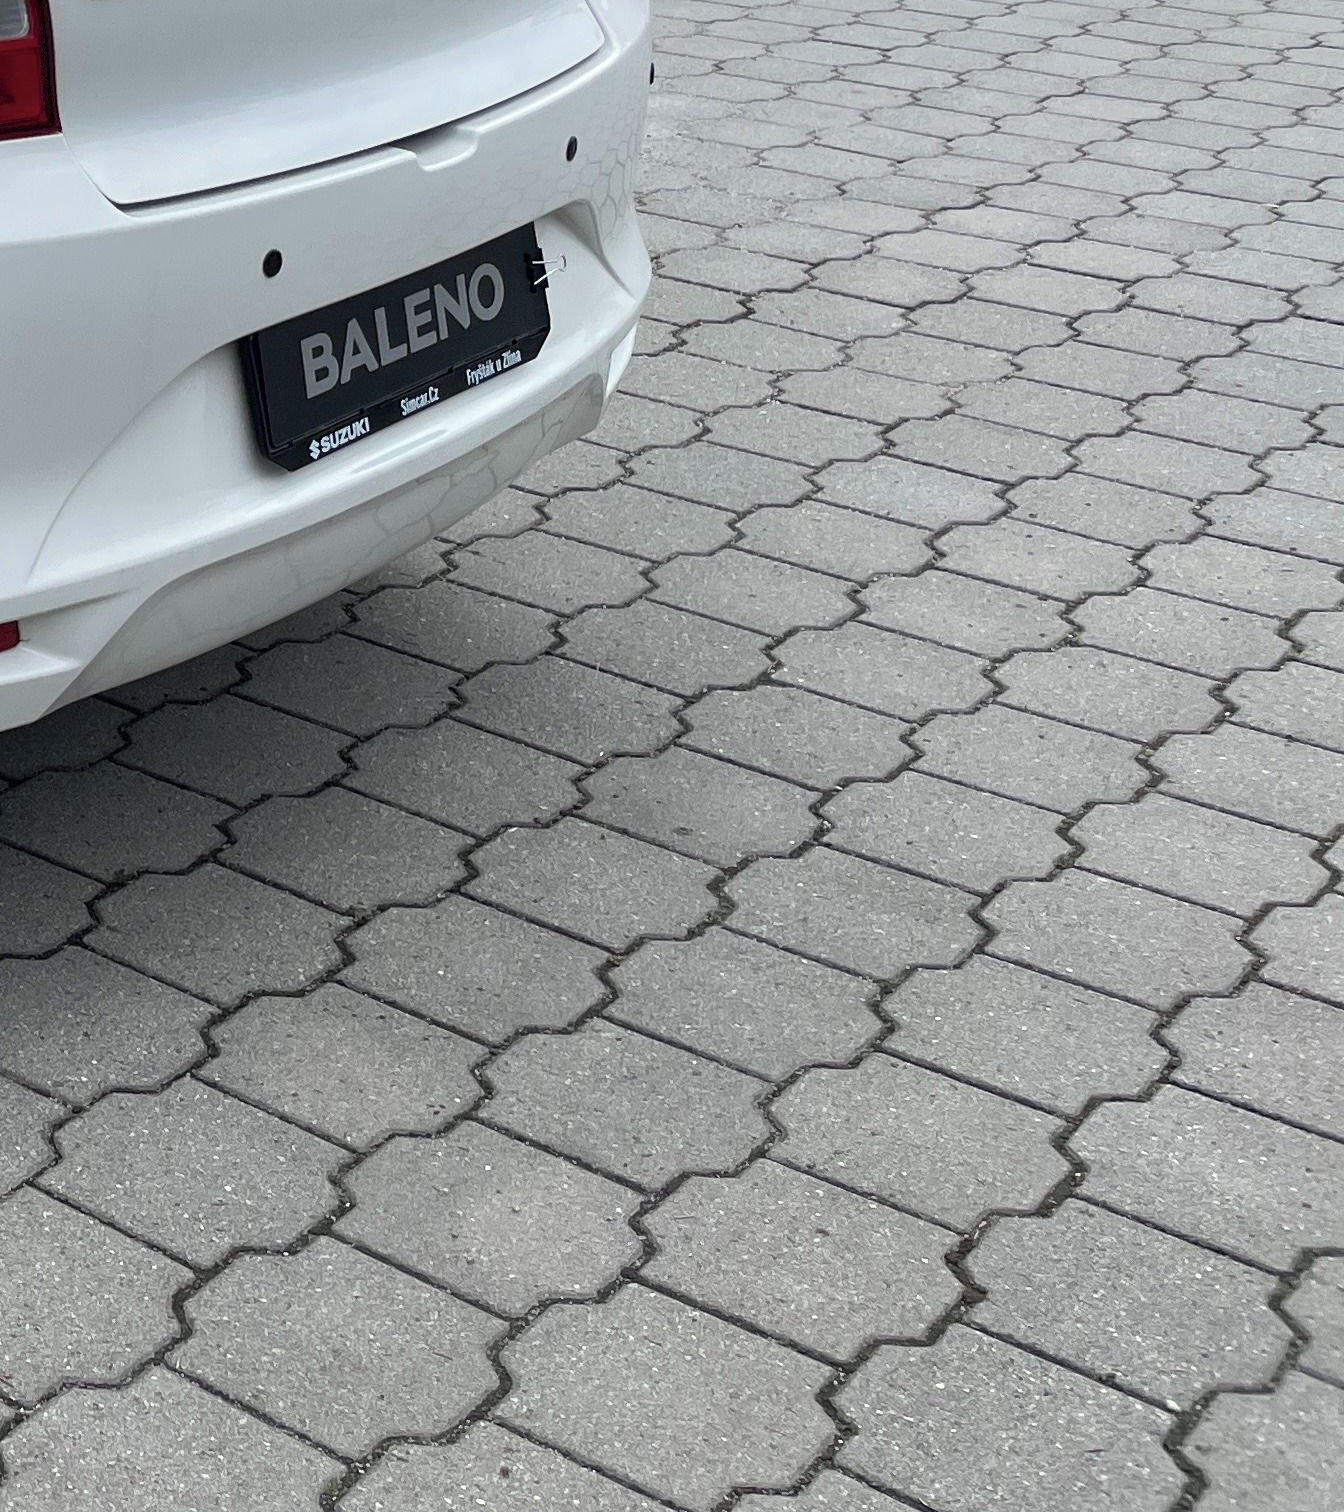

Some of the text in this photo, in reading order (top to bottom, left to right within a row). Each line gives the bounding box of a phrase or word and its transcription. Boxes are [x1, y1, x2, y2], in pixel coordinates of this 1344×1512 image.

[299, 262, 506, 400] BALENO
[466, 361, 495, 386] Fryšták
[496, 360, 502, 372] u
[320, 417, 370, 453] SUZUKI
